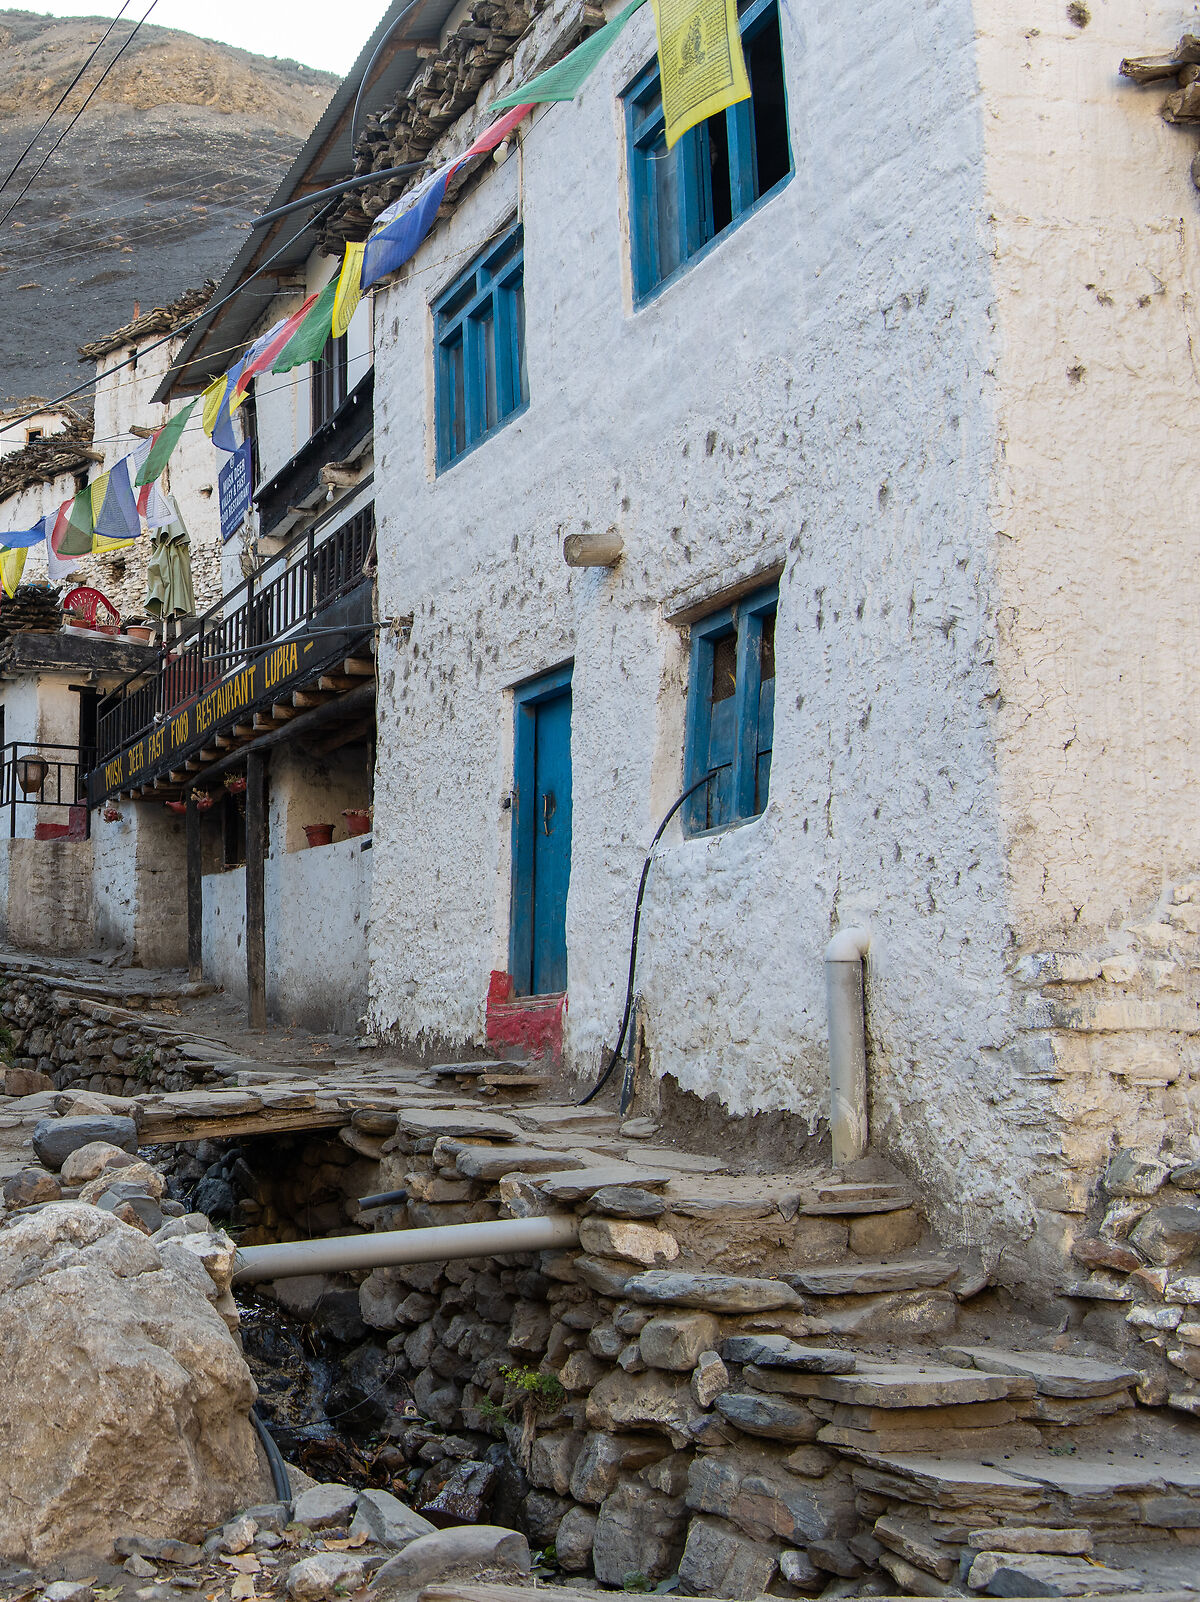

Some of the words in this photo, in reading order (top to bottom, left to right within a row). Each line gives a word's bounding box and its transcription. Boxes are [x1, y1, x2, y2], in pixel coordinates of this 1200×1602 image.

[222, 470, 234, 495] MUSK
[233, 458, 245, 481] DEER
[236, 472, 246, 493] FAST
[228, 481, 250, 518] RESTAURANT
[105, 756, 124, 791] MUSK
[128, 741, 144, 776] DEER
[148, 726, 166, 764] FAST
[171, 710, 189, 749] FOOD
[196, 664, 257, 734] RESTAURANT
[265, 642, 298, 688] LUPRA
